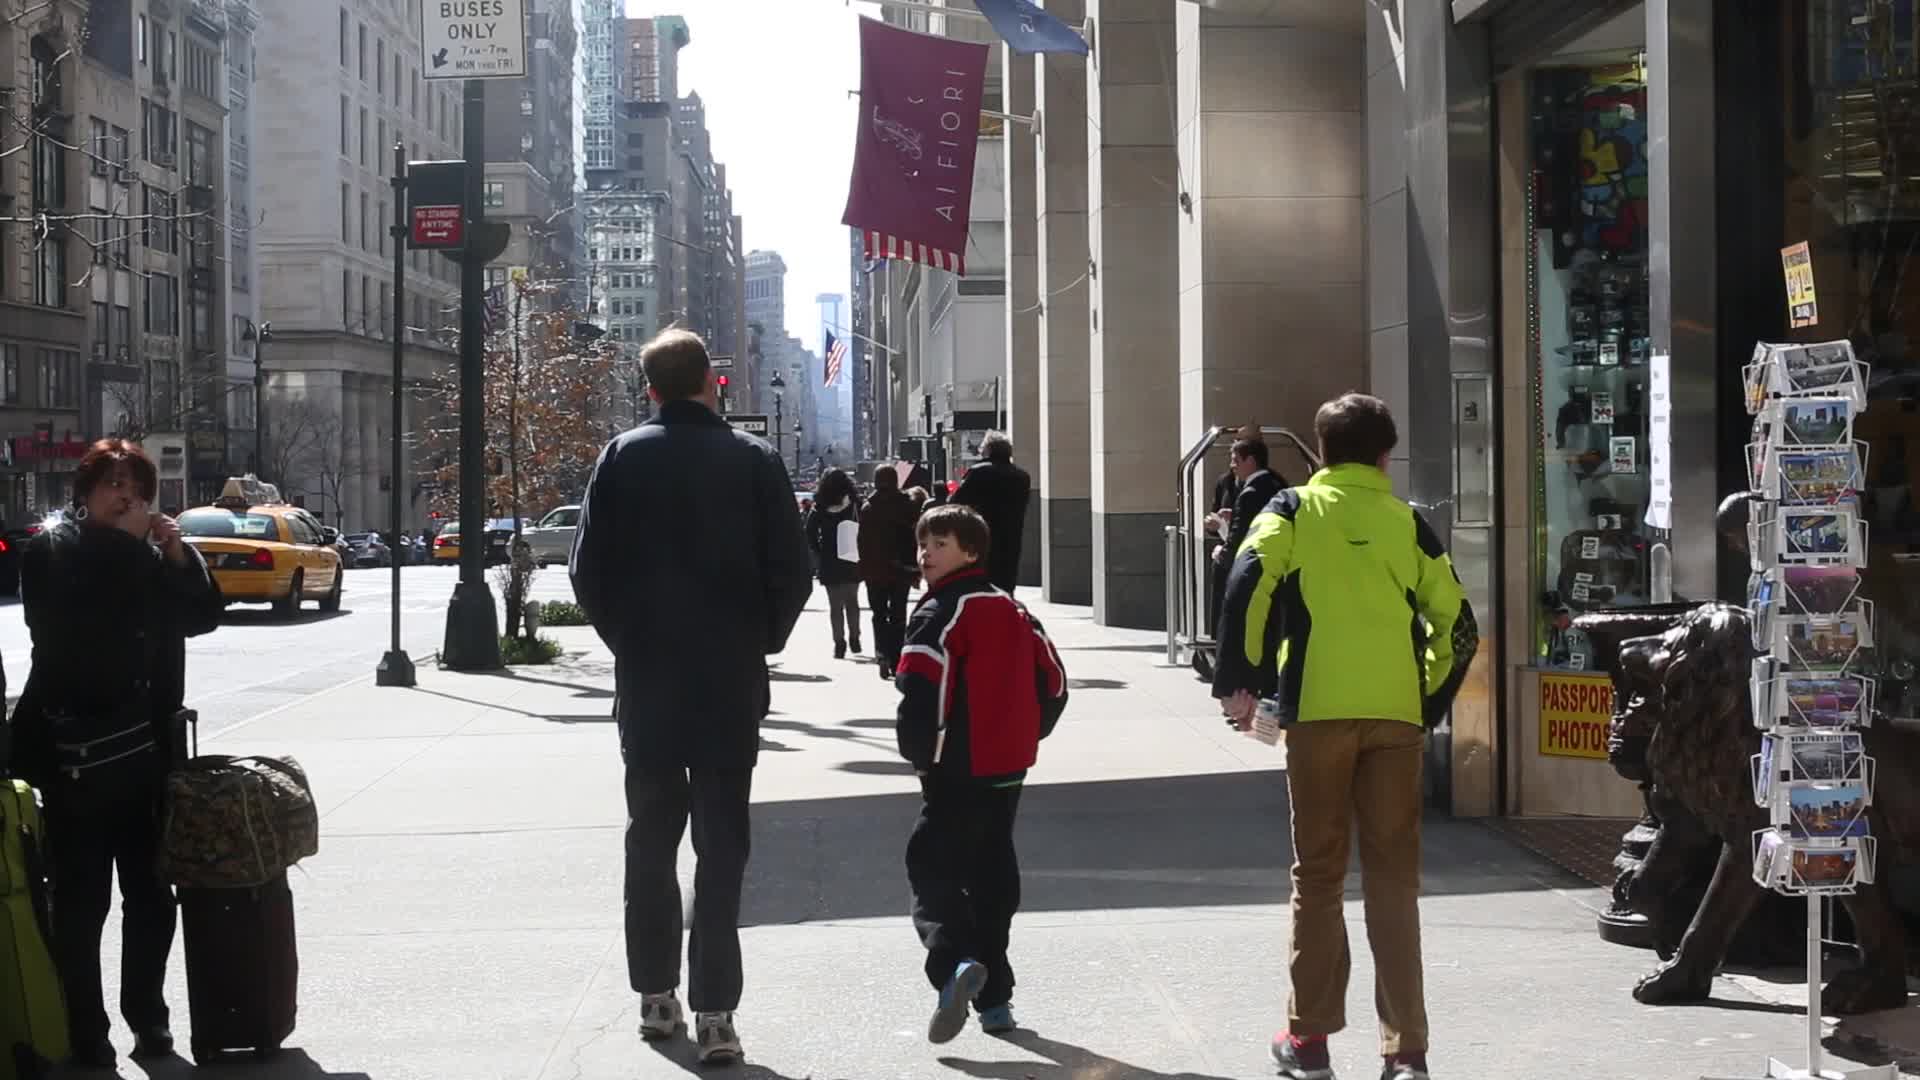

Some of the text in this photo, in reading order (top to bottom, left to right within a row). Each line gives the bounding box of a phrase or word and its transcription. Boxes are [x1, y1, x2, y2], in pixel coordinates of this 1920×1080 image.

[440, 0, 503, 18] BUSES
[448, 22, 497, 40] ONLY
[455, 60, 475, 70] MON
[938, 69, 968, 169] FIORI
[1542, 682, 1611, 715] PASSPOR
